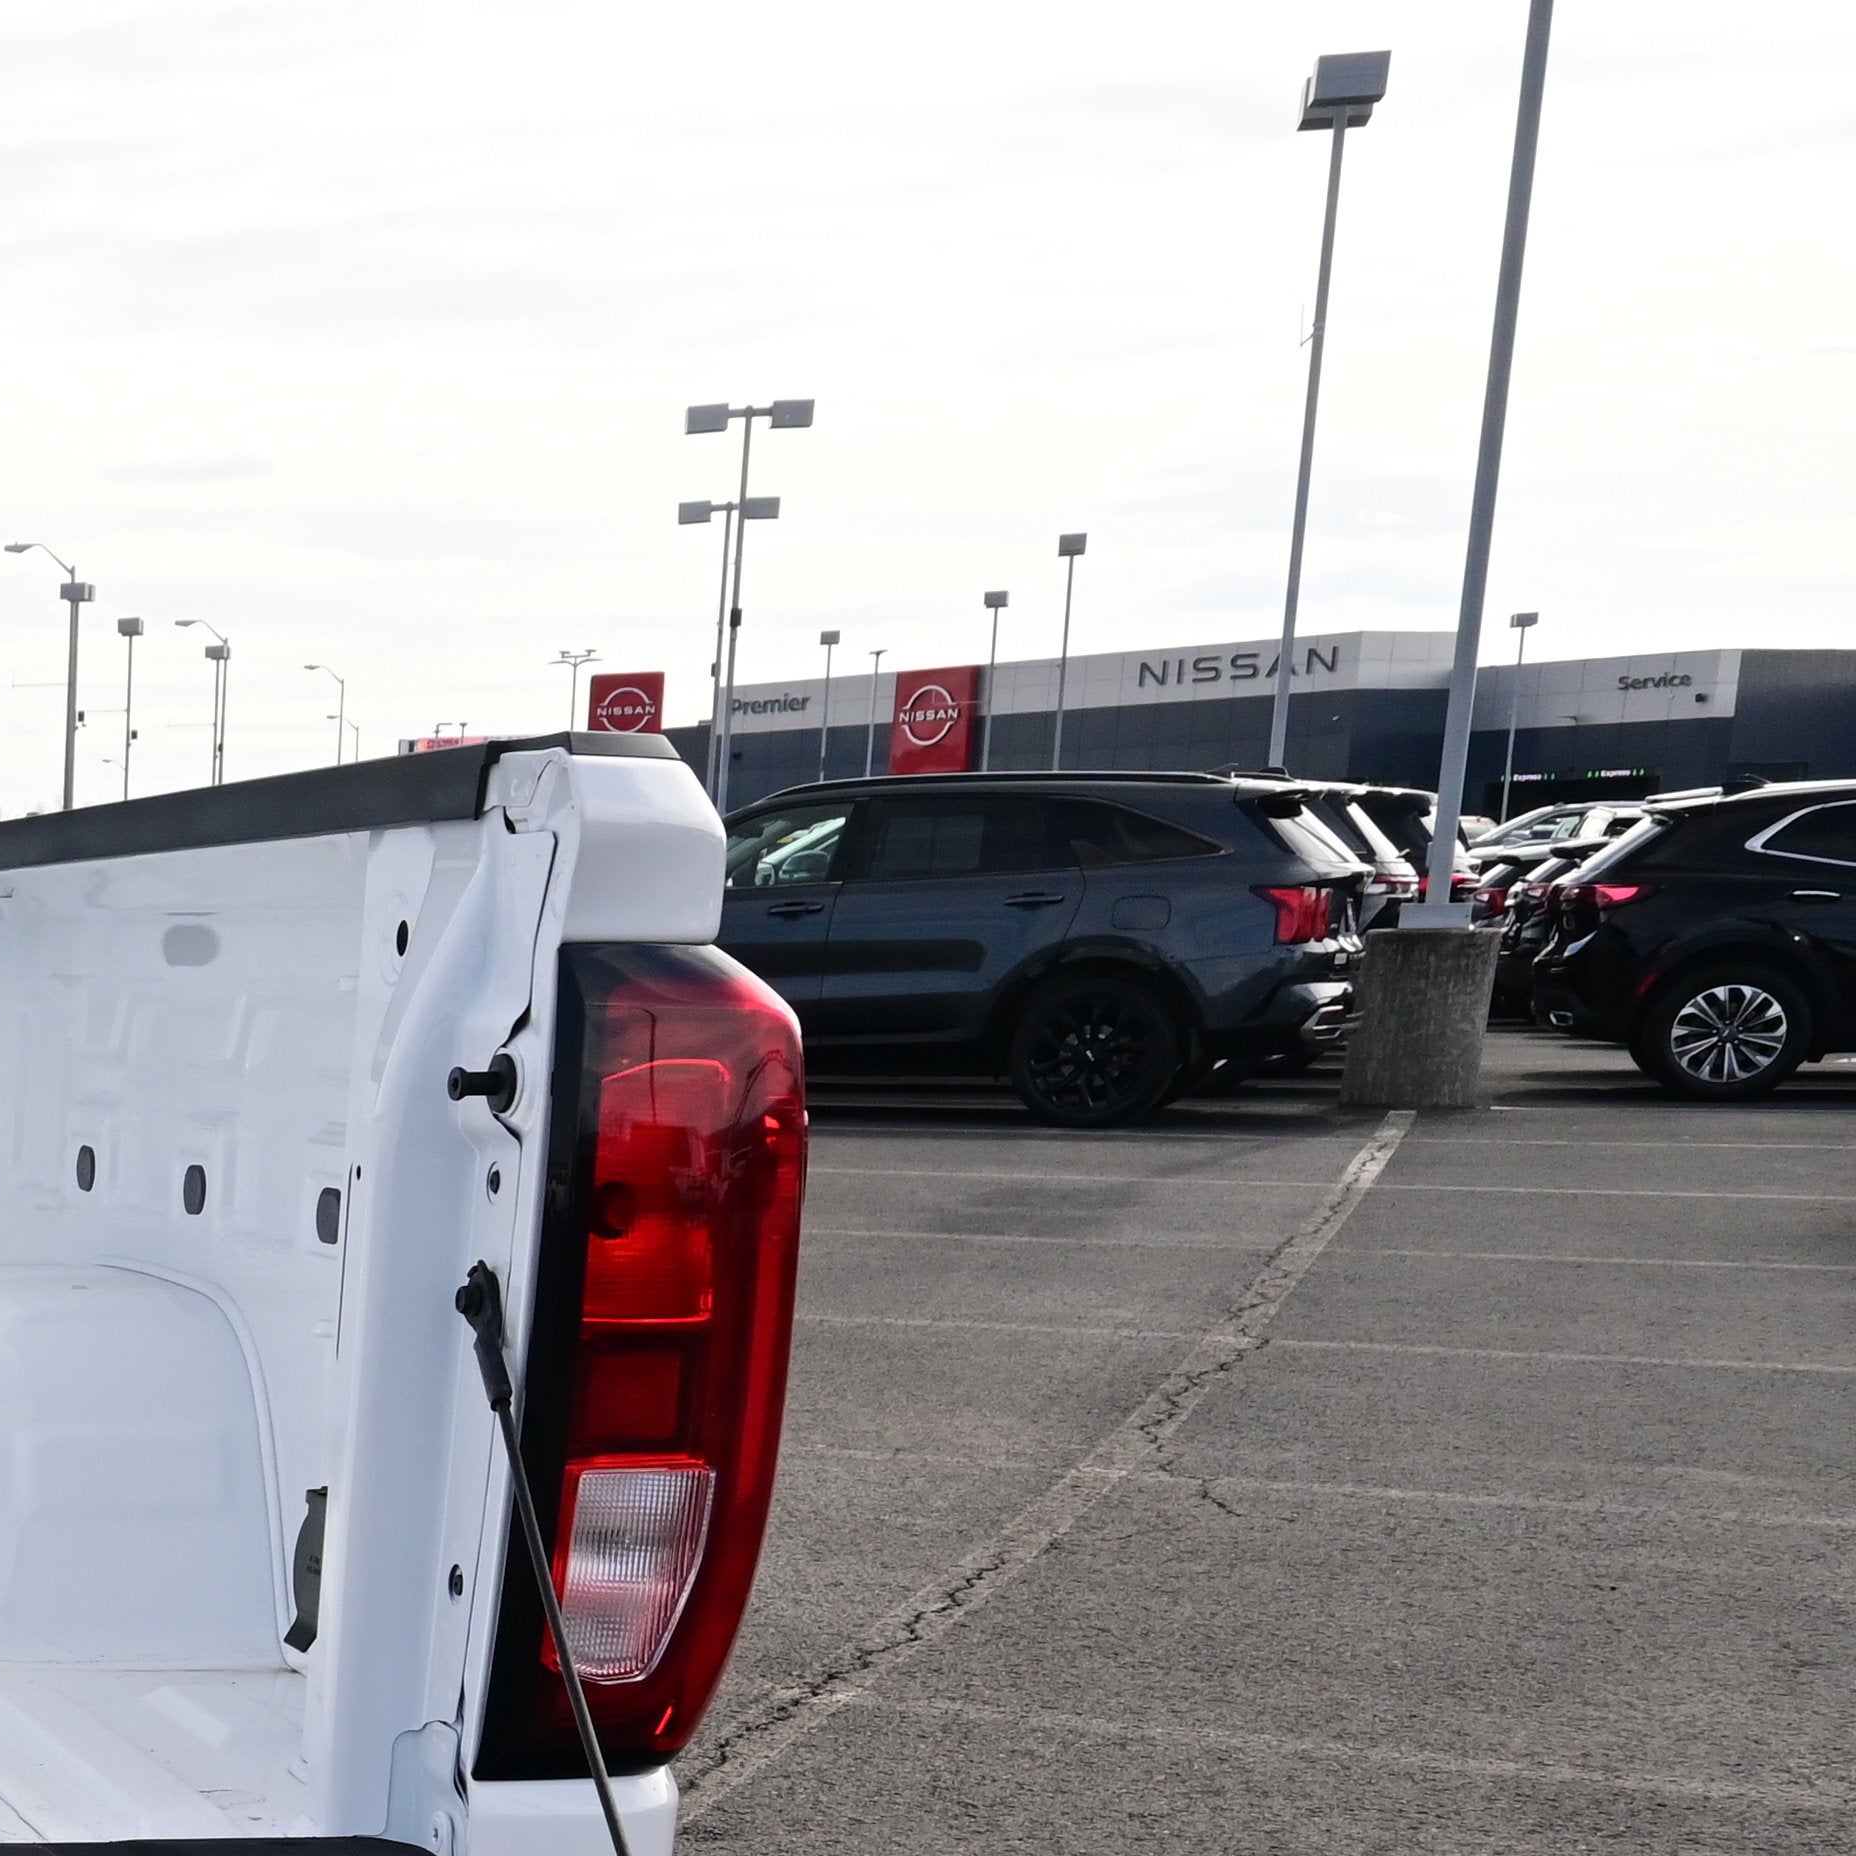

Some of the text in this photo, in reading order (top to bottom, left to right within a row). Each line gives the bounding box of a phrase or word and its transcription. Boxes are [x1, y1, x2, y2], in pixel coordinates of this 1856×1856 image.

[1138, 645, 1339, 687] NISSAN
[1617, 672, 1692, 690] Service
[597, 705, 656, 717] NISSAN
[731, 693, 811, 717] Premier
[898, 708, 959, 723] NISSAN
[1513, 773, 1542, 782] Express
[1601, 769, 1631, 778] Express
